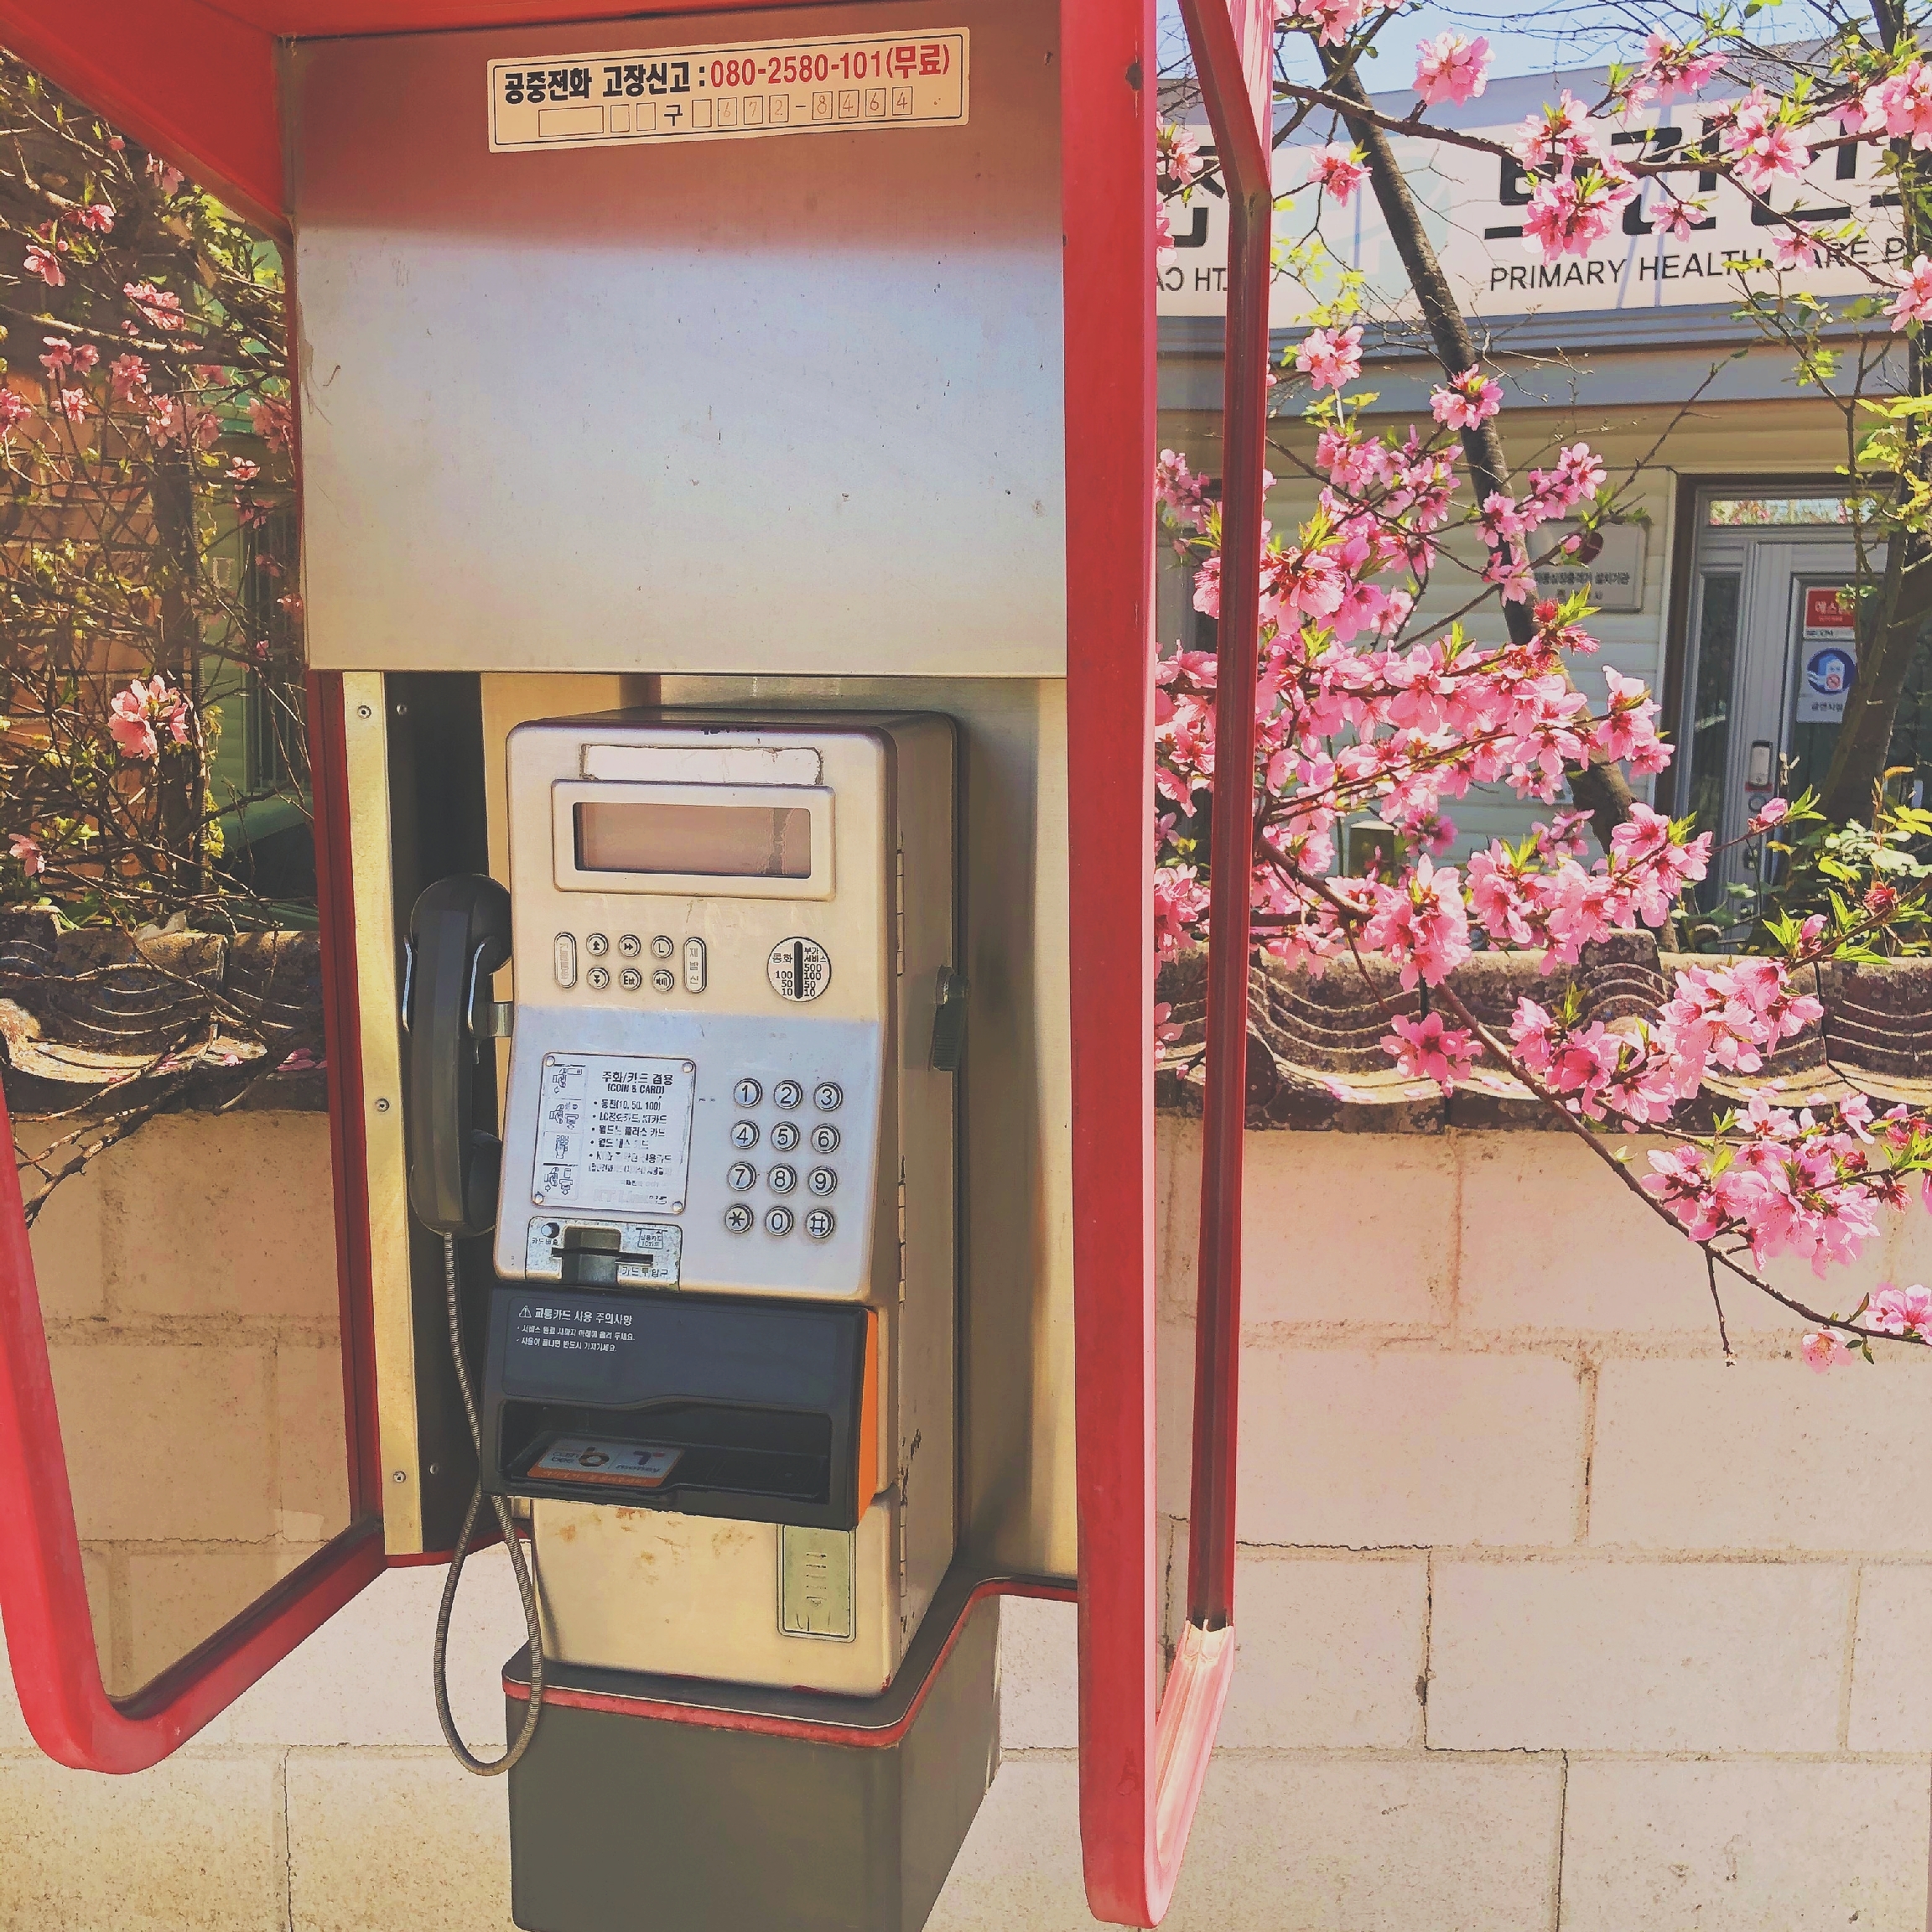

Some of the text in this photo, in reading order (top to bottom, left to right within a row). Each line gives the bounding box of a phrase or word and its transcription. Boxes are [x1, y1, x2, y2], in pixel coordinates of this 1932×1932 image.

[504, 67, 592, 105] 공중전화
[603, 64, 691, 97] 고장신고
[663, 105, 684, 127] 구
[1490, 258, 1626, 291] PRIMARY
[1639, 248, 1762, 283] HEALTH
[804, 947, 818, 955] 부가
[804, 963, 822, 973] 500
[776, 970, 793, 979] 100
[804, 972, 822, 981] 100
[781, 979, 793, 988] 50
[804, 980, 816, 989] 50
[782, 988, 793, 996] 10
[804, 989, 816, 997] 10
[741, 1084, 833, 1106] 1 2 3
[735, 1126, 829, 1148] 4 5 6
[735, 1168, 827, 1191] 7 8 9
[771, 1212, 783, 1231] 0
[574, 1310, 593, 1323] 사용
